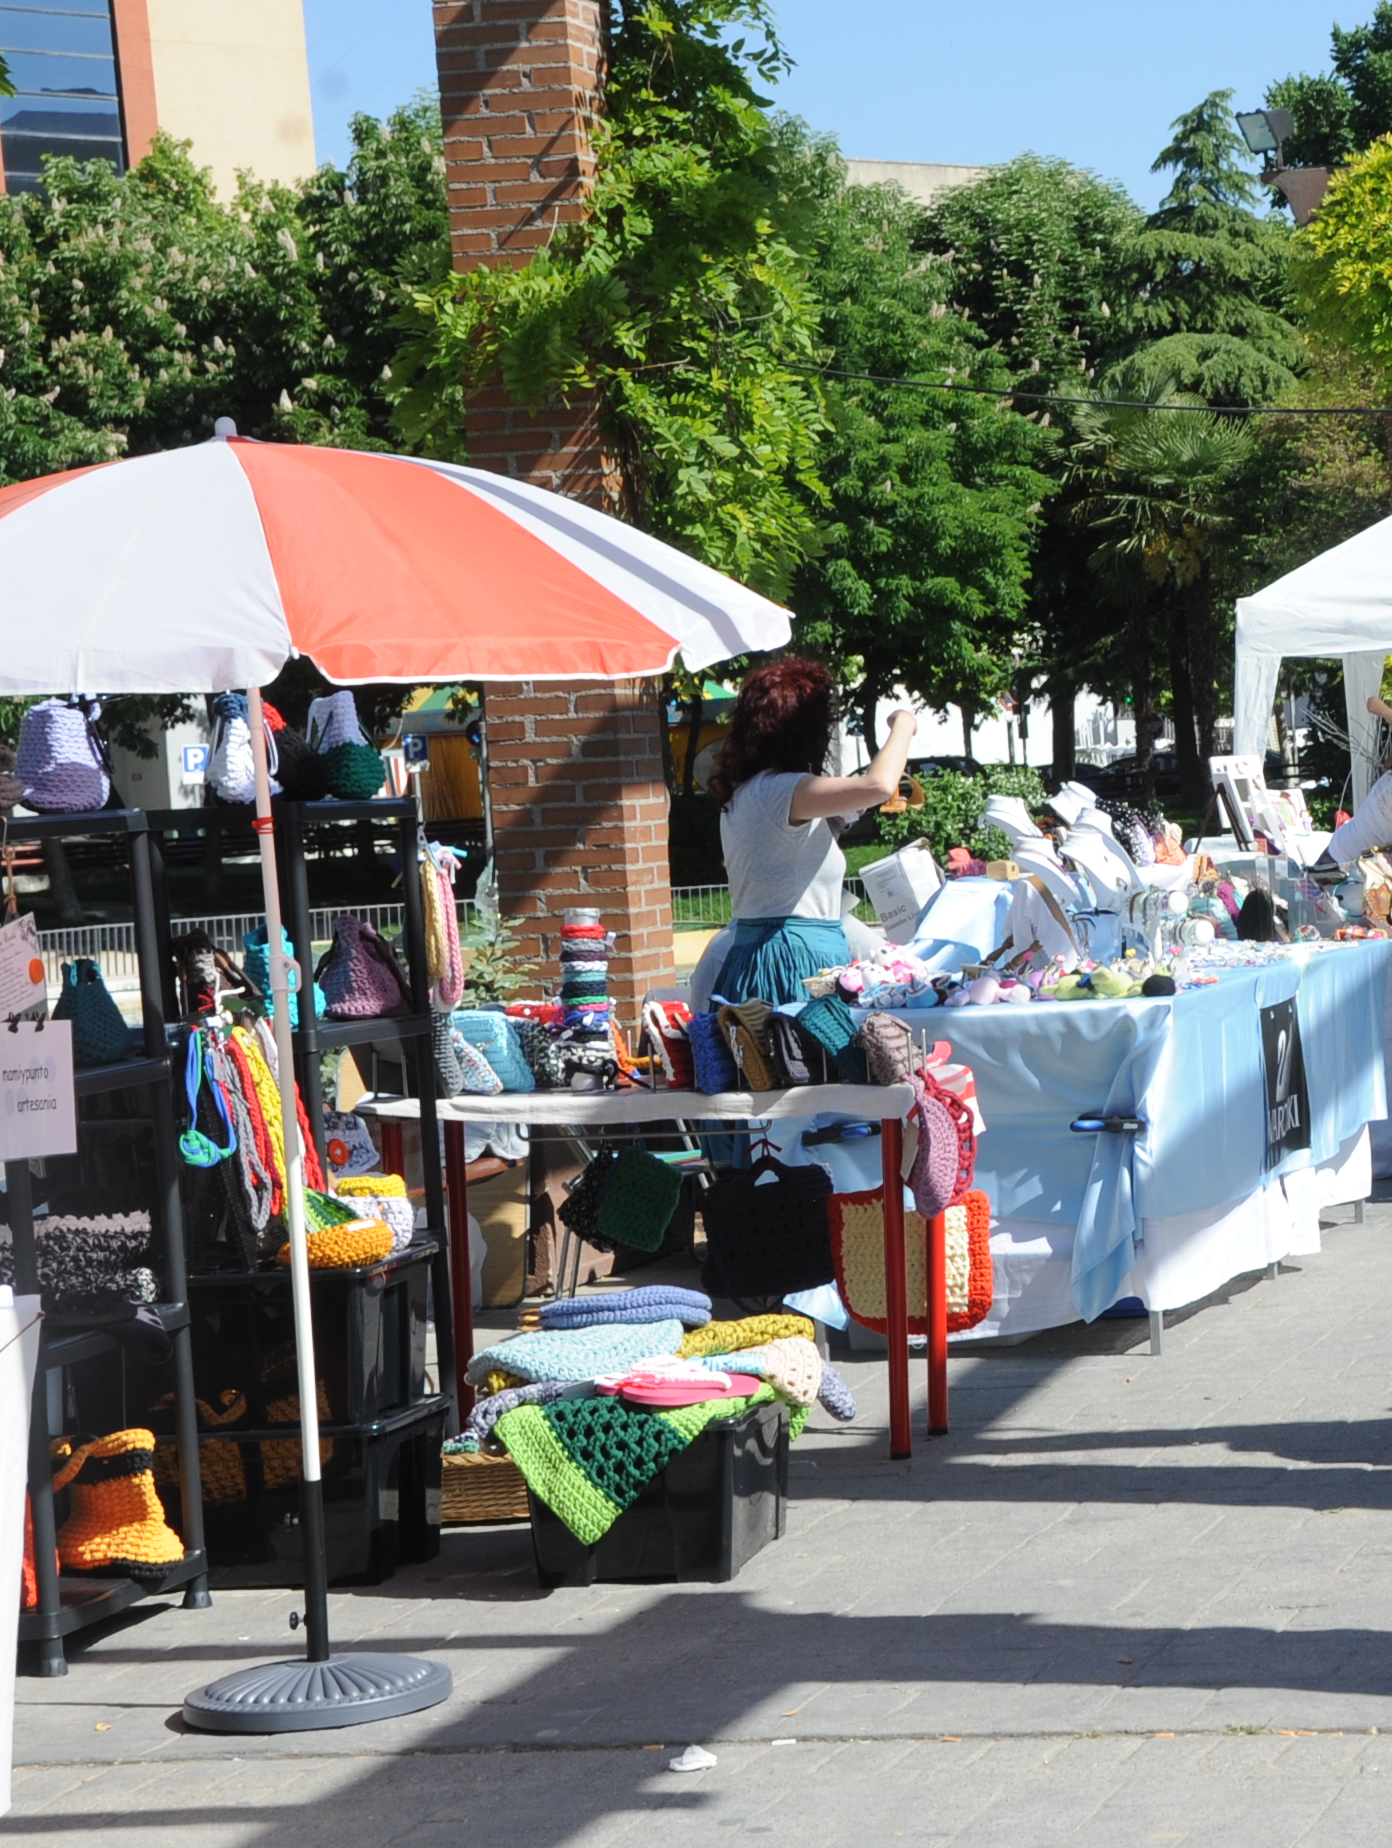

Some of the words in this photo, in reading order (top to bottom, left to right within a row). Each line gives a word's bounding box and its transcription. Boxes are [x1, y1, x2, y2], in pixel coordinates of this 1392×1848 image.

[409, 738, 423, 758] P
[187, 748, 205, 771] P
[880, 904, 907, 923] Basic
[17, 1093, 57, 1113] artesania
